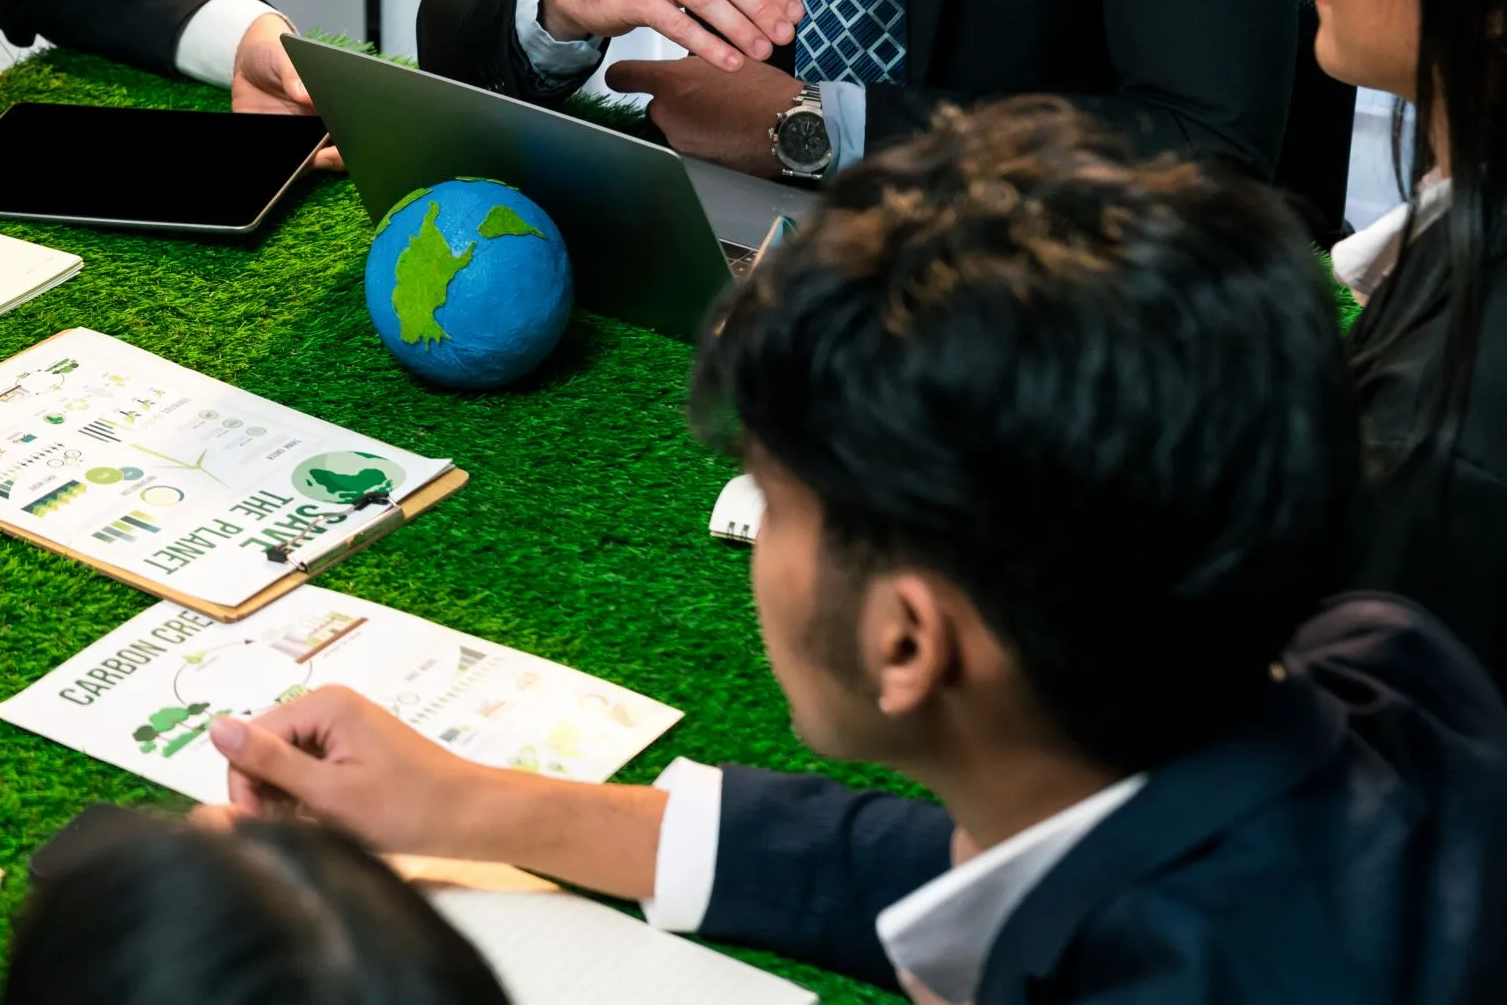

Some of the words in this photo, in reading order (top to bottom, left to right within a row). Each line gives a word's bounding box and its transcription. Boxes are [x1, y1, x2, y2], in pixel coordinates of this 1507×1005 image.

[229, 490, 294, 521] THE
[144, 518, 243, 575] PLANET
[59, 639, 168, 706] CARBON
[151, 610, 214, 644] CRE
